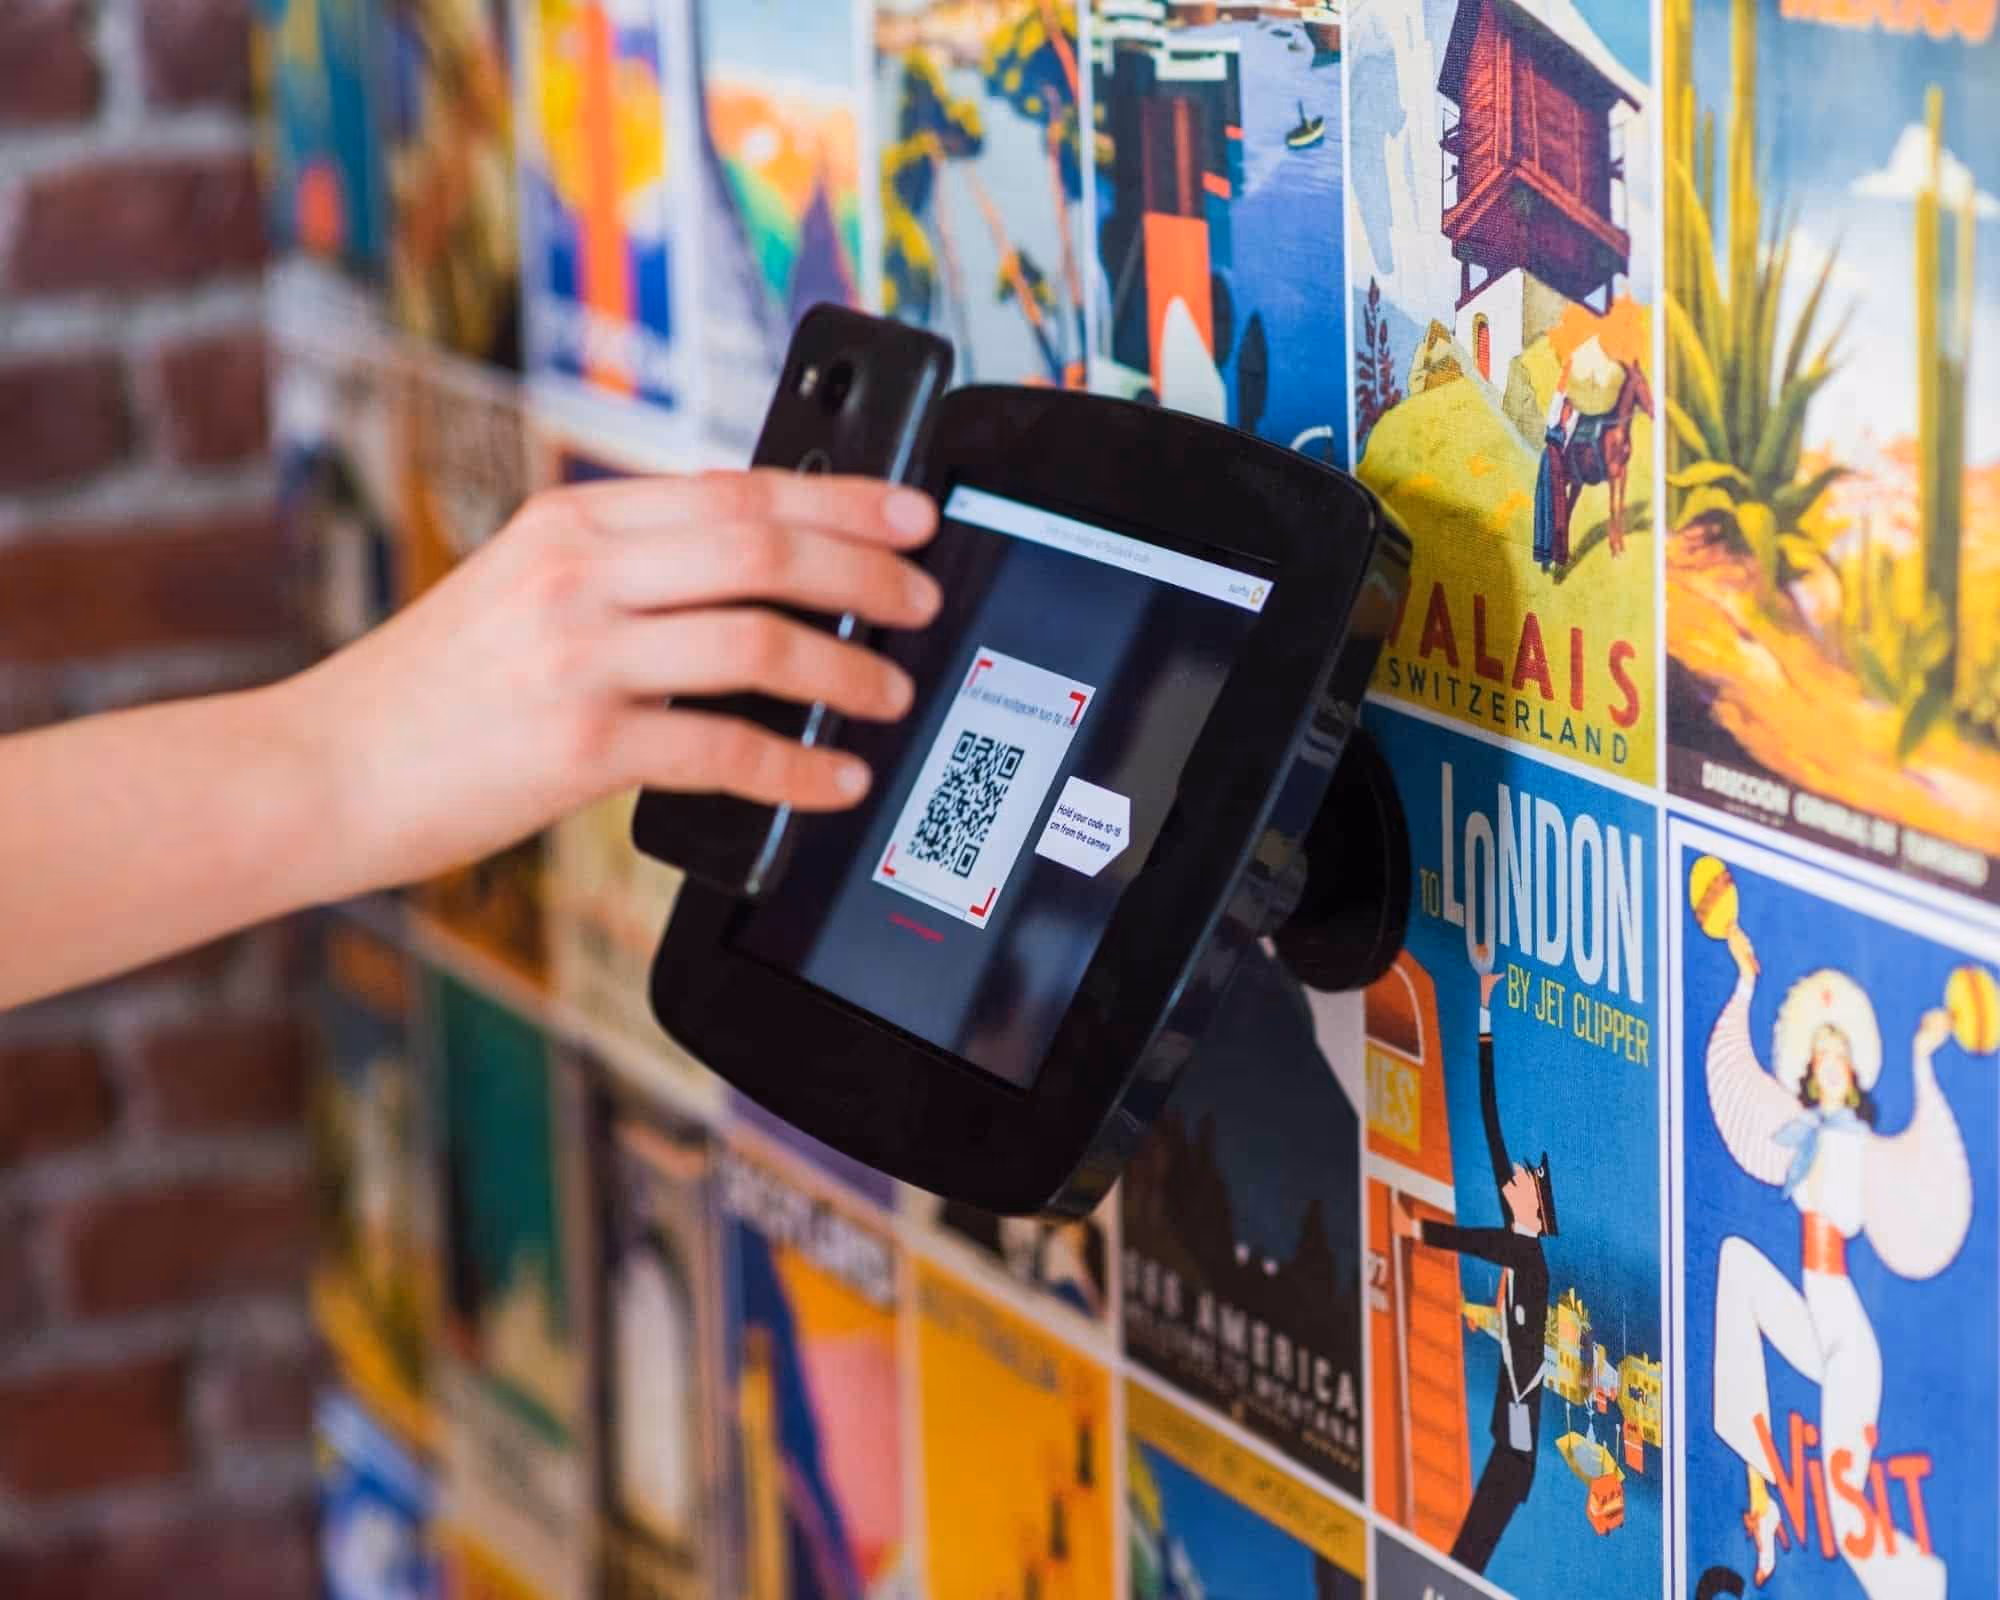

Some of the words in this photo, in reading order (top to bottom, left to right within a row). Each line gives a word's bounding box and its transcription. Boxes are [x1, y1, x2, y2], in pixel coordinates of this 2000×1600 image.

[1387, 656, 1629, 764] SWITZERLAND
[1049, 821, 1061, 831] cm
[1059, 823, 1077, 838] from
[1075, 829, 1088, 843] the
[1086, 836, 1112, 853] camera
[1056, 804, 1074, 819] Hold
[1071, 812, 1089, 824] your
[1087, 817, 1104, 831] code
[1420, 868, 1440, 918] TO
[1507, 963, 1532, 1014] BY
[1534, 977, 1567, 1030] JET
[1573, 992, 1650, 1068] CLIPPER
[1196, 1291, 1359, 1420] AMERICA
